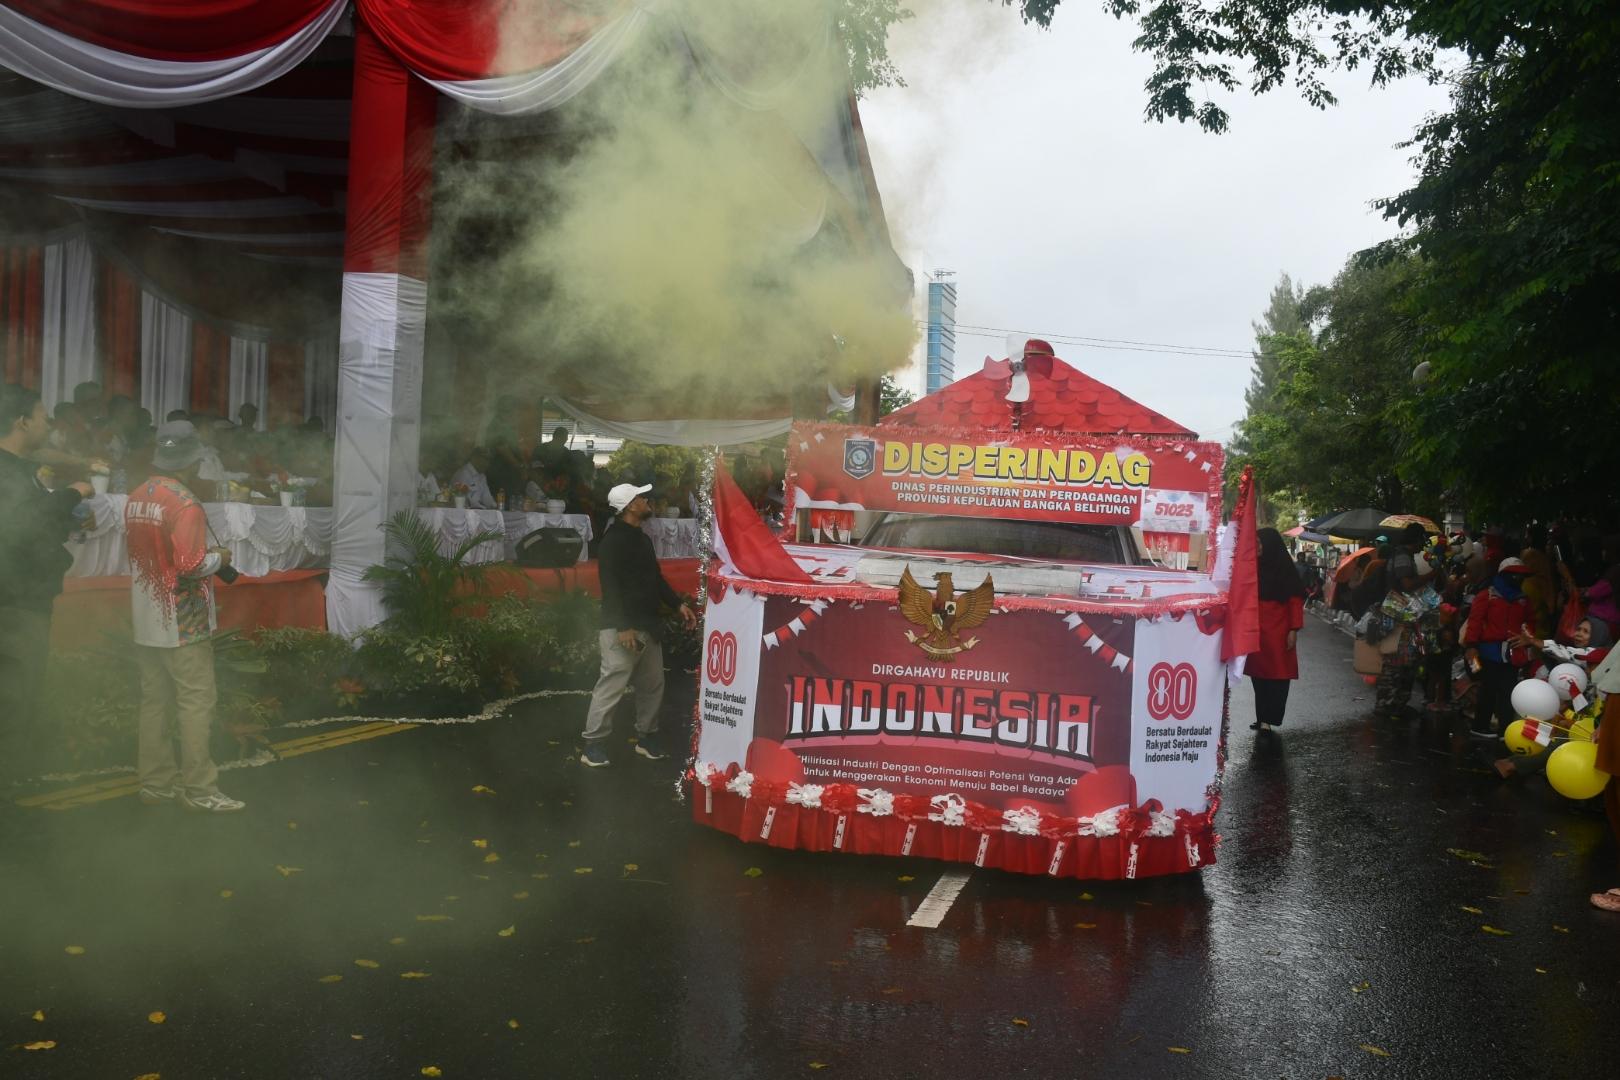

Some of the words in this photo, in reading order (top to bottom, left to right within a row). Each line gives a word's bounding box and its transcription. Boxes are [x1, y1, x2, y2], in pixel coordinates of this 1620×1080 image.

[882, 441, 1151, 488] DISPERINDAG
[892, 481, 926, 492] DINAS
[929, 483, 1019, 498] PERINDUSTRIAN
[1023, 488, 1046, 499] DAN
[1050, 490, 1137, 505] PERDAGANGAN
[897, 492, 950, 504] PROVINSI
[953, 495, 1020, 508] KEPULAUAN
[1023, 499, 1071, 512] BANGKA
[1074, 503, 1131, 516] BELITUNG
[707, 630, 738, 686] 80
[872, 663, 946, 680] DIRGAHAYU
[951, 668, 1009, 683] REPUBLIK
[1147, 661, 1197, 720] 80
[785, 676, 1101, 763] INDONESIA
[1146, 726, 1176, 737] Bersatu
[1176, 725, 1212, 736] Berdaulat
[1145, 739, 1172, 752] Rakyat
[1172, 738, 1208, 750] Sejahtera
[1145, 752, 1180, 763] Indonesia
[1181, 750, 1199, 763] Maju
[803, 767, 830, 777] Untuk
[833, 769, 901, 783] Menggerakan
[904, 775, 947, 787] Ekonomi
[949, 779, 987, 791] Menuju
[990, 782, 1019, 793] Babel
[1022, 785, 1070, 797] Berdaya"
[843, 758, 879, 769] Industri
[882, 762, 921, 773] Dengan
[924, 765, 986, 779] Optimalisasi
[989, 770, 1025, 781] Potensi
[1028, 773, 1054, 785] Yang
[1056, 775, 1078, 785] Ada
